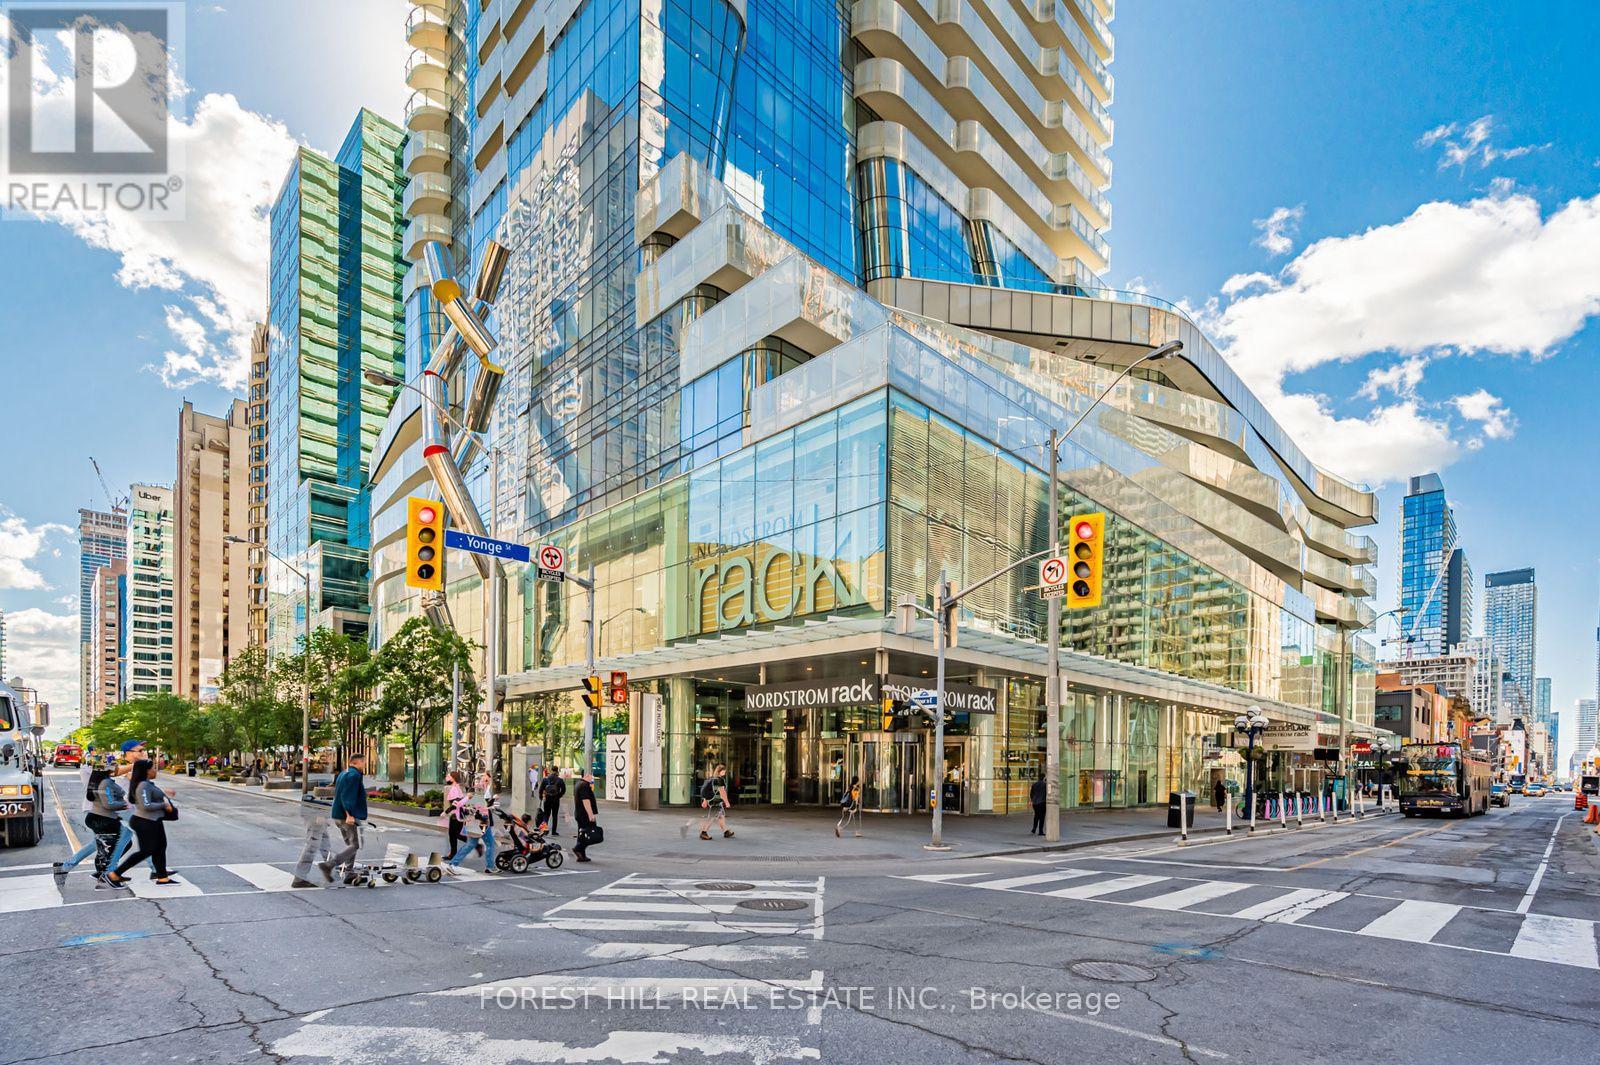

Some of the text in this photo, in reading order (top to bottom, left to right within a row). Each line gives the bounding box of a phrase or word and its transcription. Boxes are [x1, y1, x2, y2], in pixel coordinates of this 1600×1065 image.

[138, 491, 161, 501] Uber
[467, 535, 502, 554] Yonge
[694, 503, 861, 633] rack
[746, 678, 874, 709] NORDSTROM rack
[967, 690, 995, 711] rack
[611, 736, 626, 800] rack
